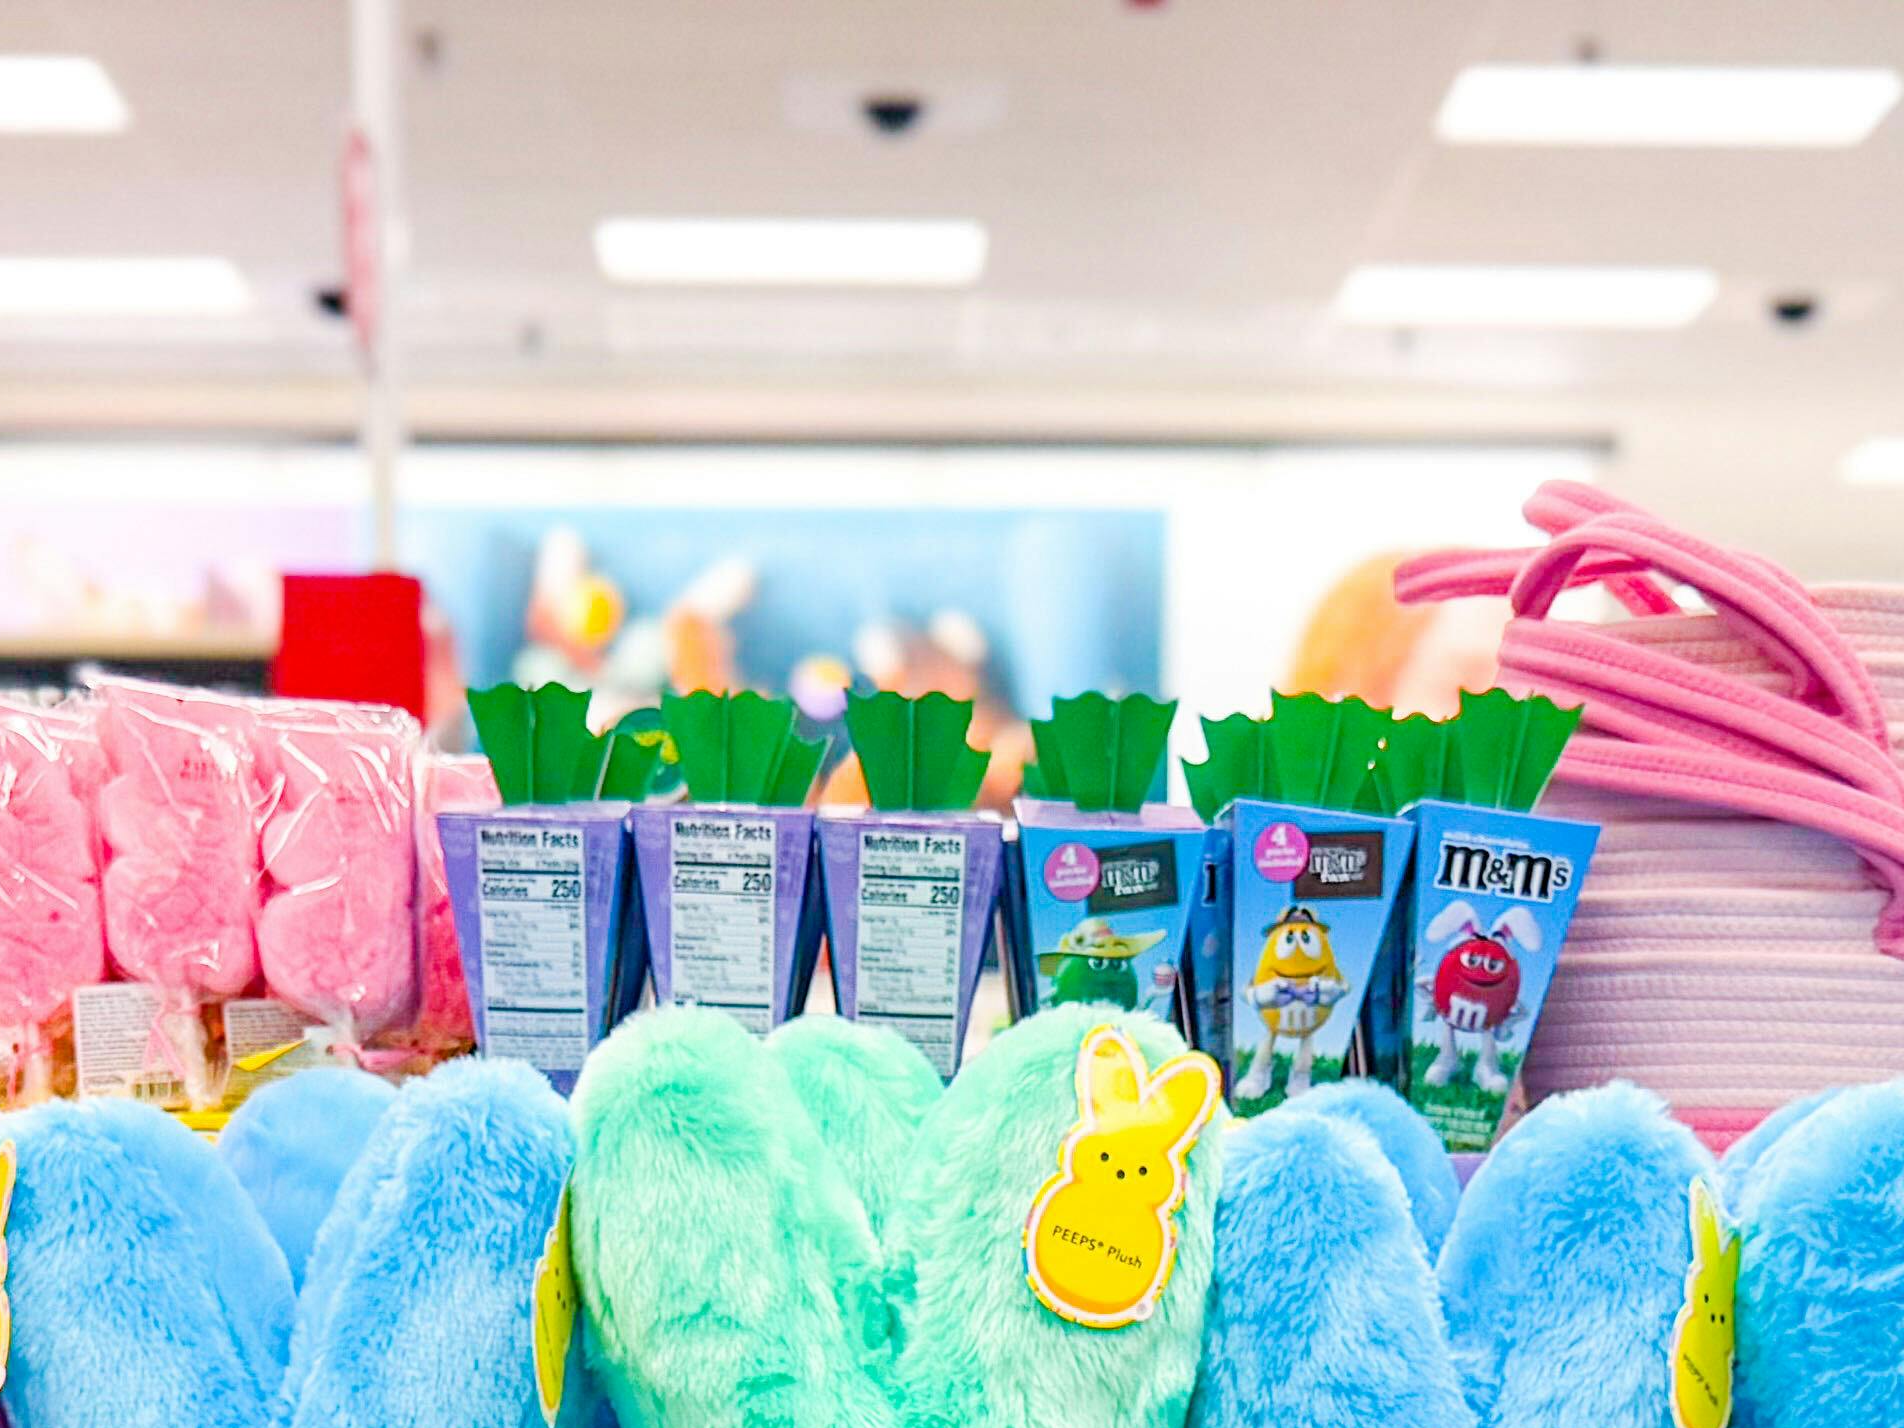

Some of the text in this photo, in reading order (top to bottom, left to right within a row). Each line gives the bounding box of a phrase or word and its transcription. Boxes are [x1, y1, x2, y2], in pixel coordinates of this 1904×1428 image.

[481, 829, 579, 848] Nutrition Facts
[675, 821, 772, 840] Nutrition Facts
[1271, 827, 1286, 846] 4
[863, 835, 961, 854] Nutrition Facts
[552, 880, 581, 898] 250
[743, 873, 772, 892] 250
[930, 886, 960, 904] 250
[1107, 1246, 1142, 1269] Plush
